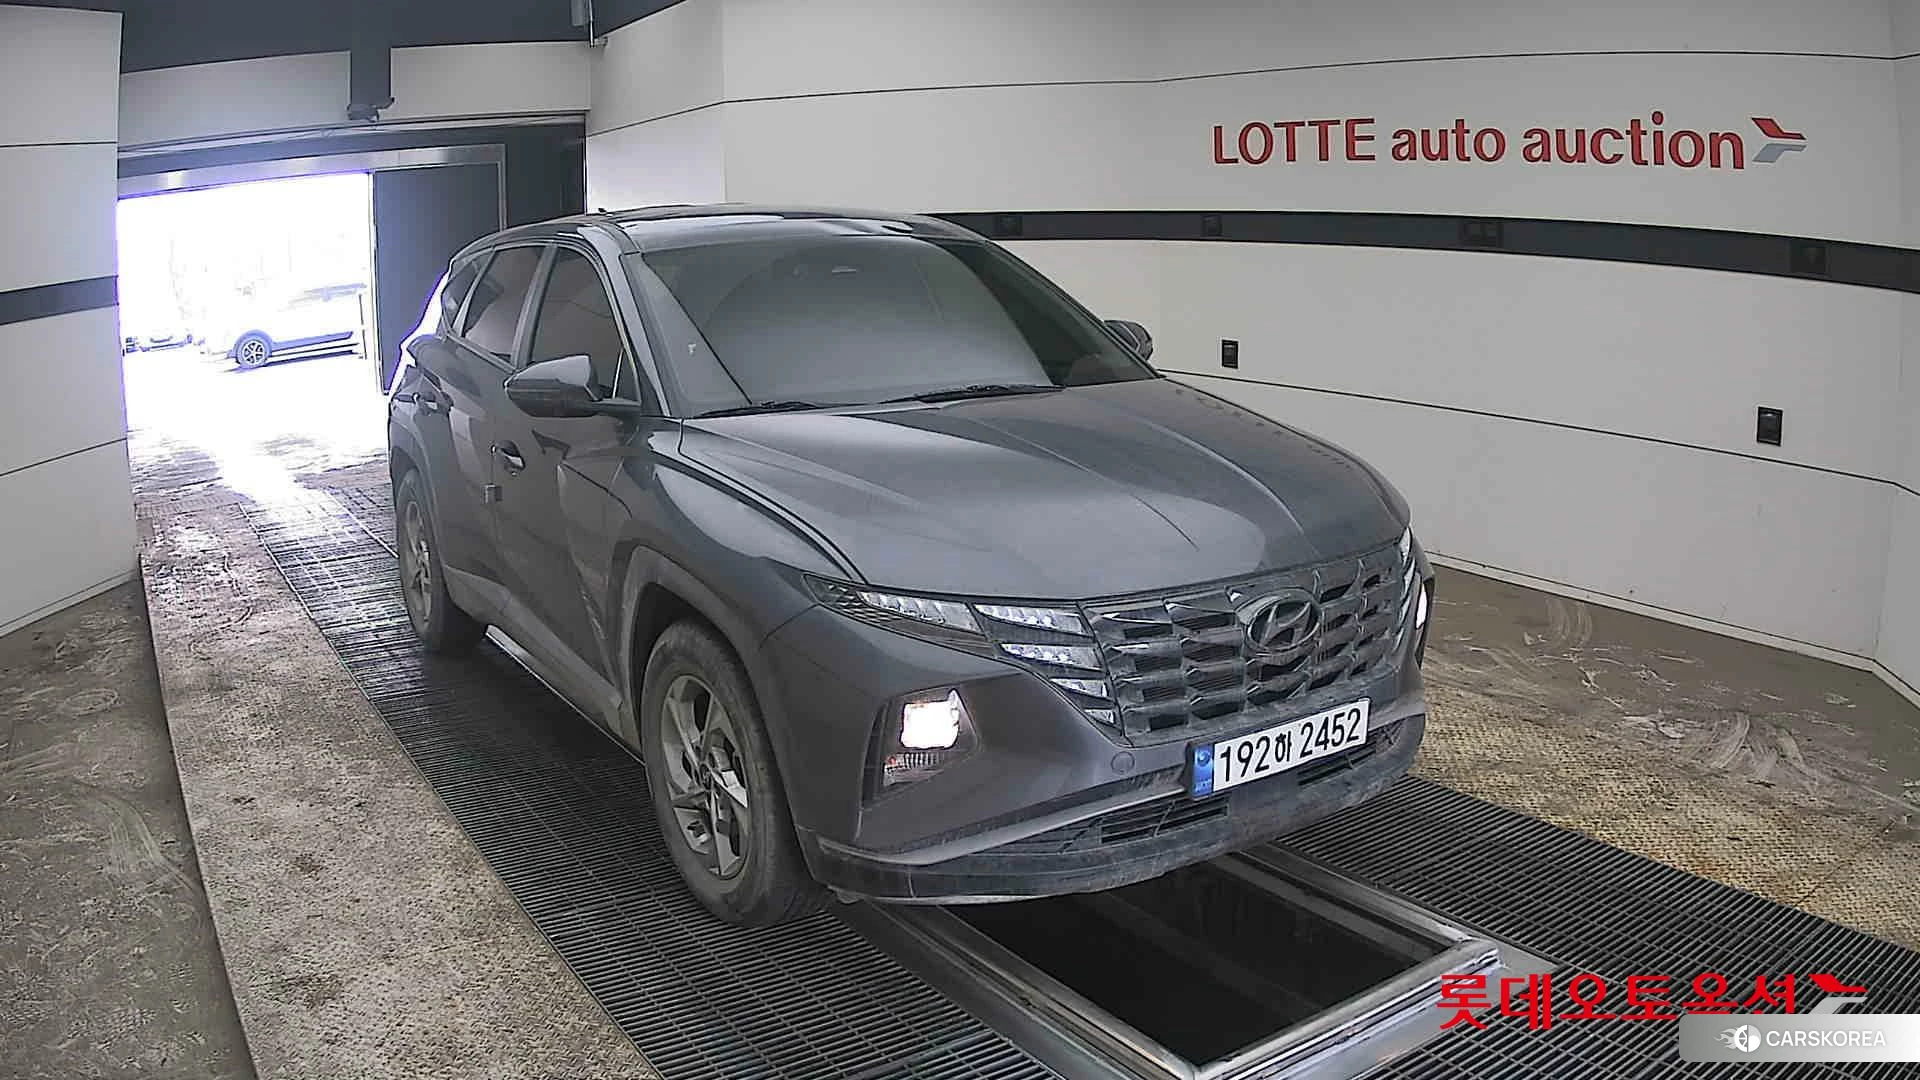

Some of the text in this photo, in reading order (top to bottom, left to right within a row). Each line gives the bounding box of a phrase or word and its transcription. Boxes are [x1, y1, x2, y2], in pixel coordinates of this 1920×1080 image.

[1212, 111, 1745, 170] LOTTE auto auction
[1220, 708, 1361, 782] 192하 2452
